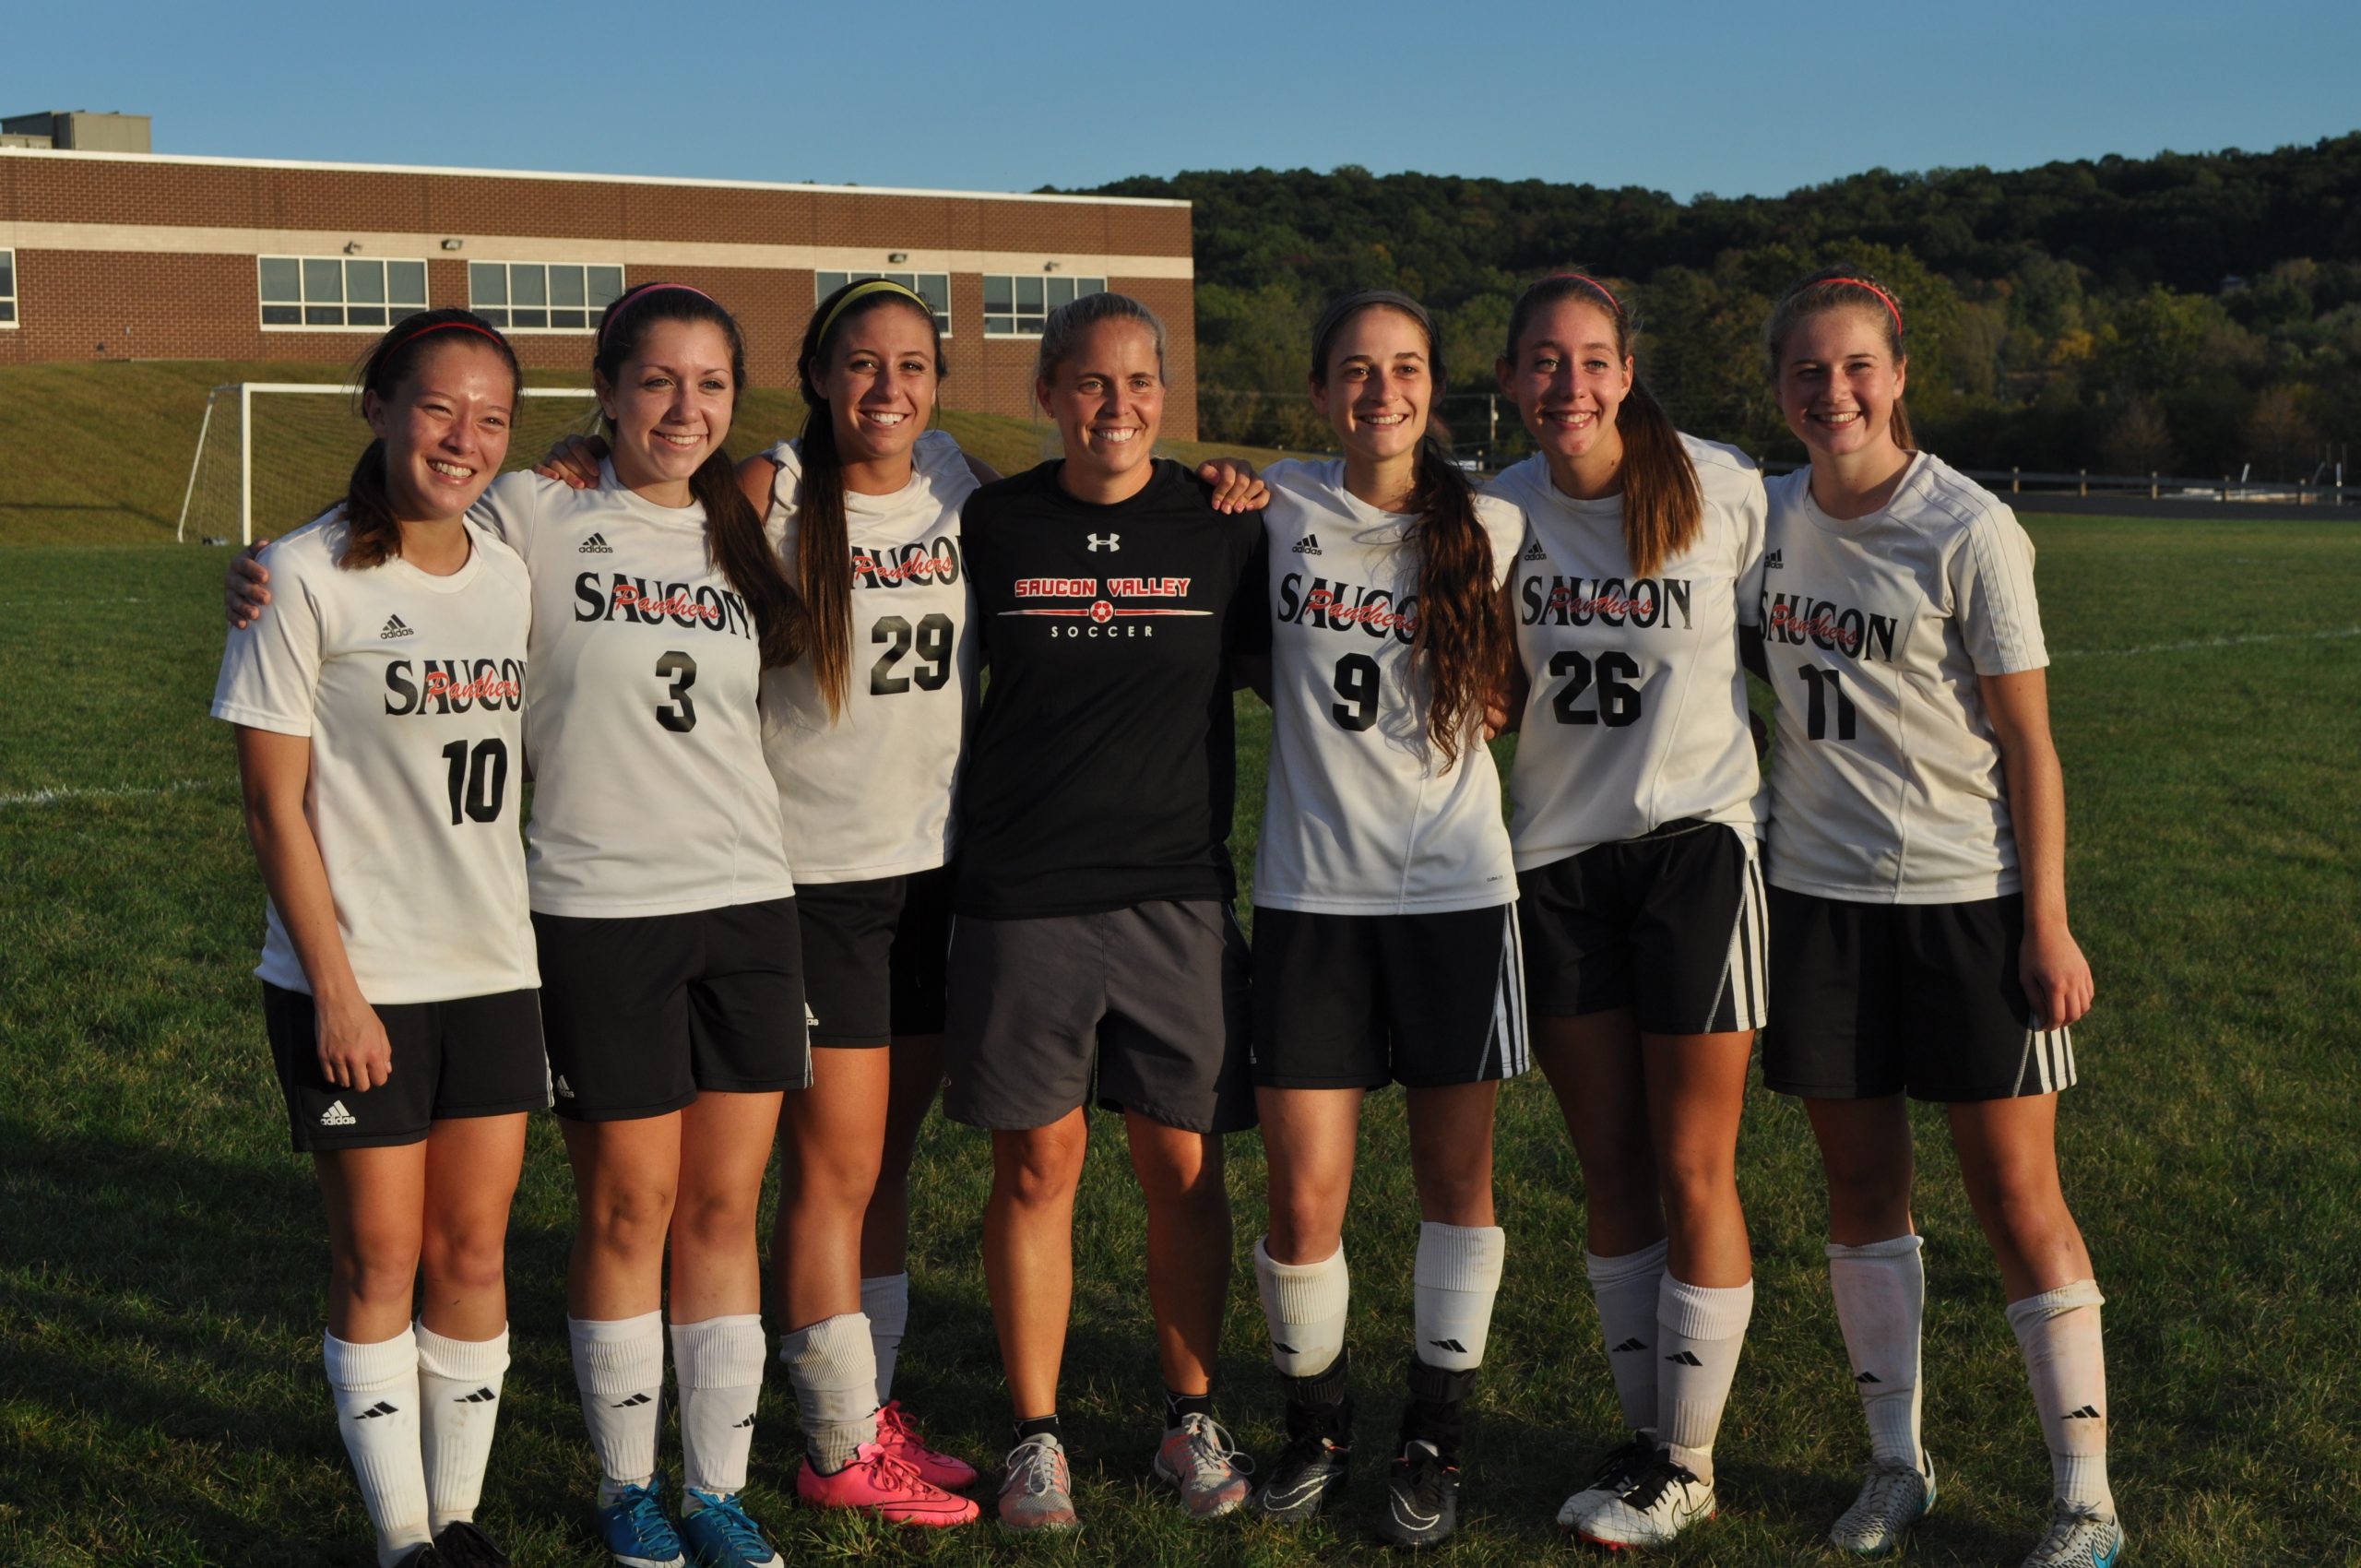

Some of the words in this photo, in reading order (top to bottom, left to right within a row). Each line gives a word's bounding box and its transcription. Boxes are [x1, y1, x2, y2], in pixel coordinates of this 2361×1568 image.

[579, 544, 613, 553] adidas
[850, 535, 968, 590] AUCO
[853, 551, 953, 580] Panthers
[1291, 545, 1323, 555] adidas
[575, 572, 751, 640] SAUCON
[612, 584, 720, 620] Panthers
[1014, 578, 1097, 598] SAUCON
[1107, 577, 1191, 598] VALLEY
[1277, 572, 1420, 645] SAUCO
[1522, 576, 1692, 630] SAUCON
[1548, 587, 1654, 617] Panthers
[1050, 625, 1153, 637] SOCCER
[1304, 588, 1418, 632] Panthers
[1759, 590, 1898, 663] SAUCON
[1771, 604, 1858, 646] Panthers
[381, 627, 414, 639] adidas
[870, 612, 955, 695] 29
[426, 670, 519, 704] Panthers
[656, 650, 696, 733] 3
[1332, 652, 1381, 731] 9
[1548, 650, 1642, 728] 26
[1798, 663, 1857, 741] 11
[442, 738, 507, 826] 10
[320, 1116, 356, 1125] adidas
